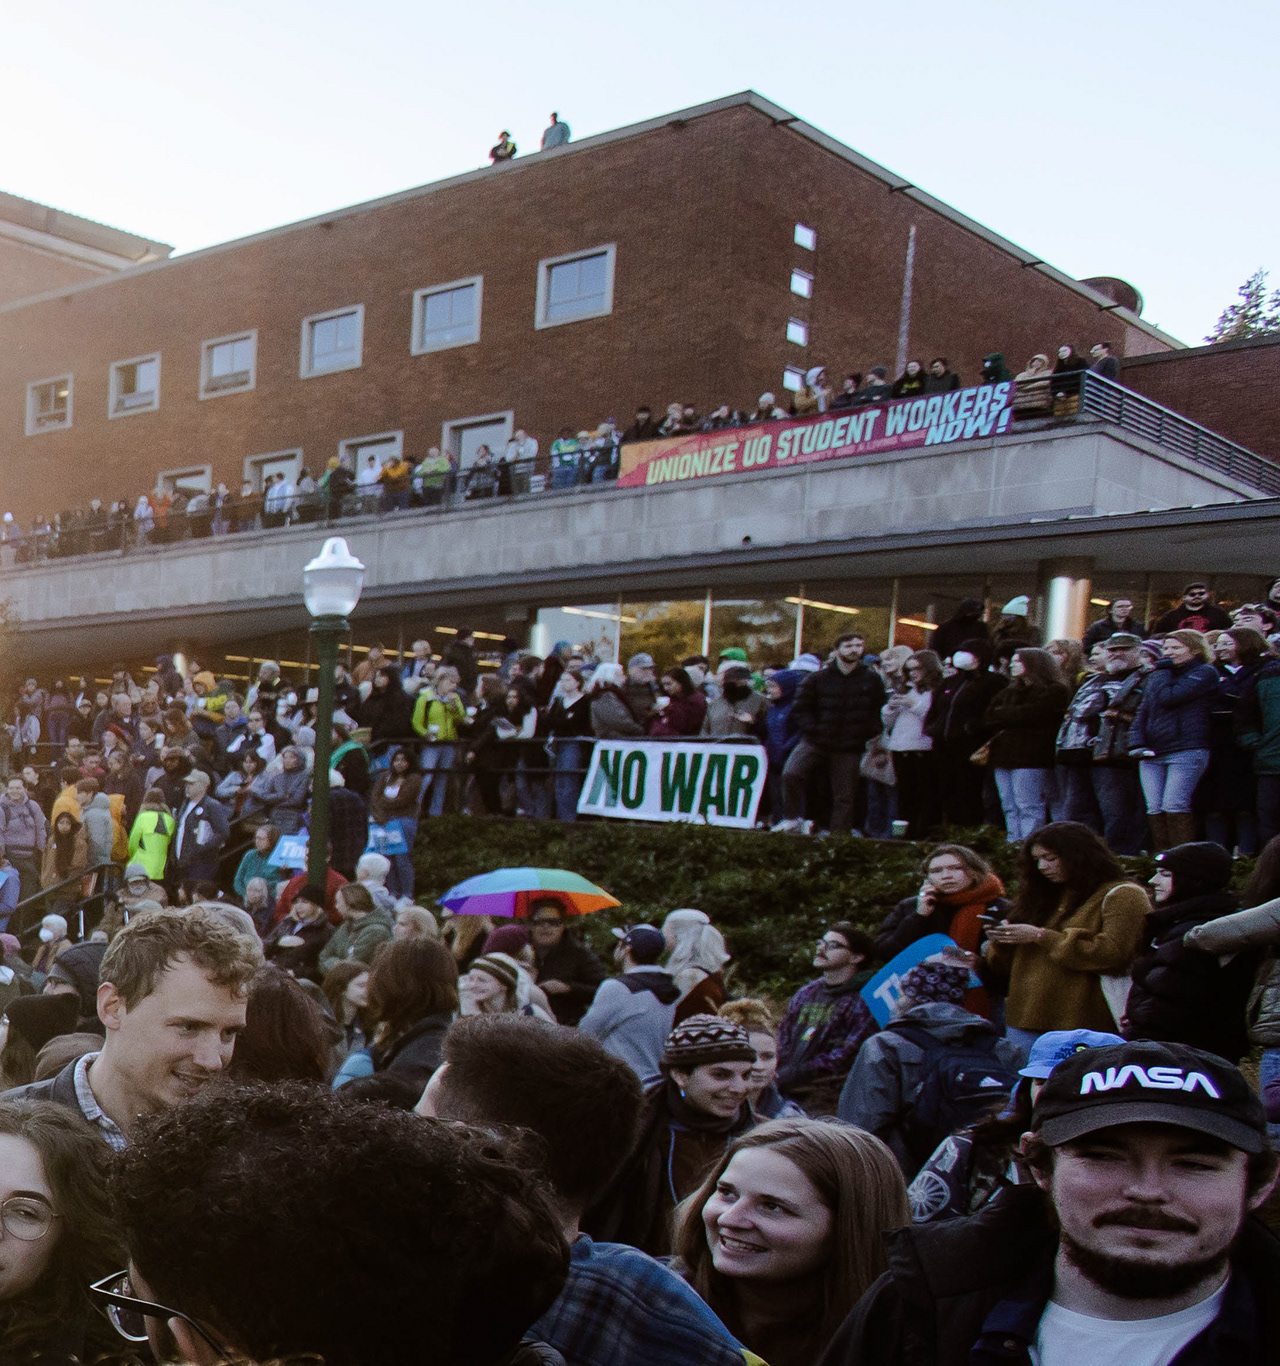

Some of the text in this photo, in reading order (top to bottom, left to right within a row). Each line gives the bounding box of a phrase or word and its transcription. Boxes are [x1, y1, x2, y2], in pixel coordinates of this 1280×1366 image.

[646, 442, 739, 485] UNIONIZE
[742, 434, 772, 467] UO
[776, 409, 881, 460] STUDENT
[885, 382, 1011, 438] WORKERS
[924, 406, 1013, 446] NOW!
[586, 749, 759, 818] NO WAR
[1079, 1064, 1222, 1099] NASA
